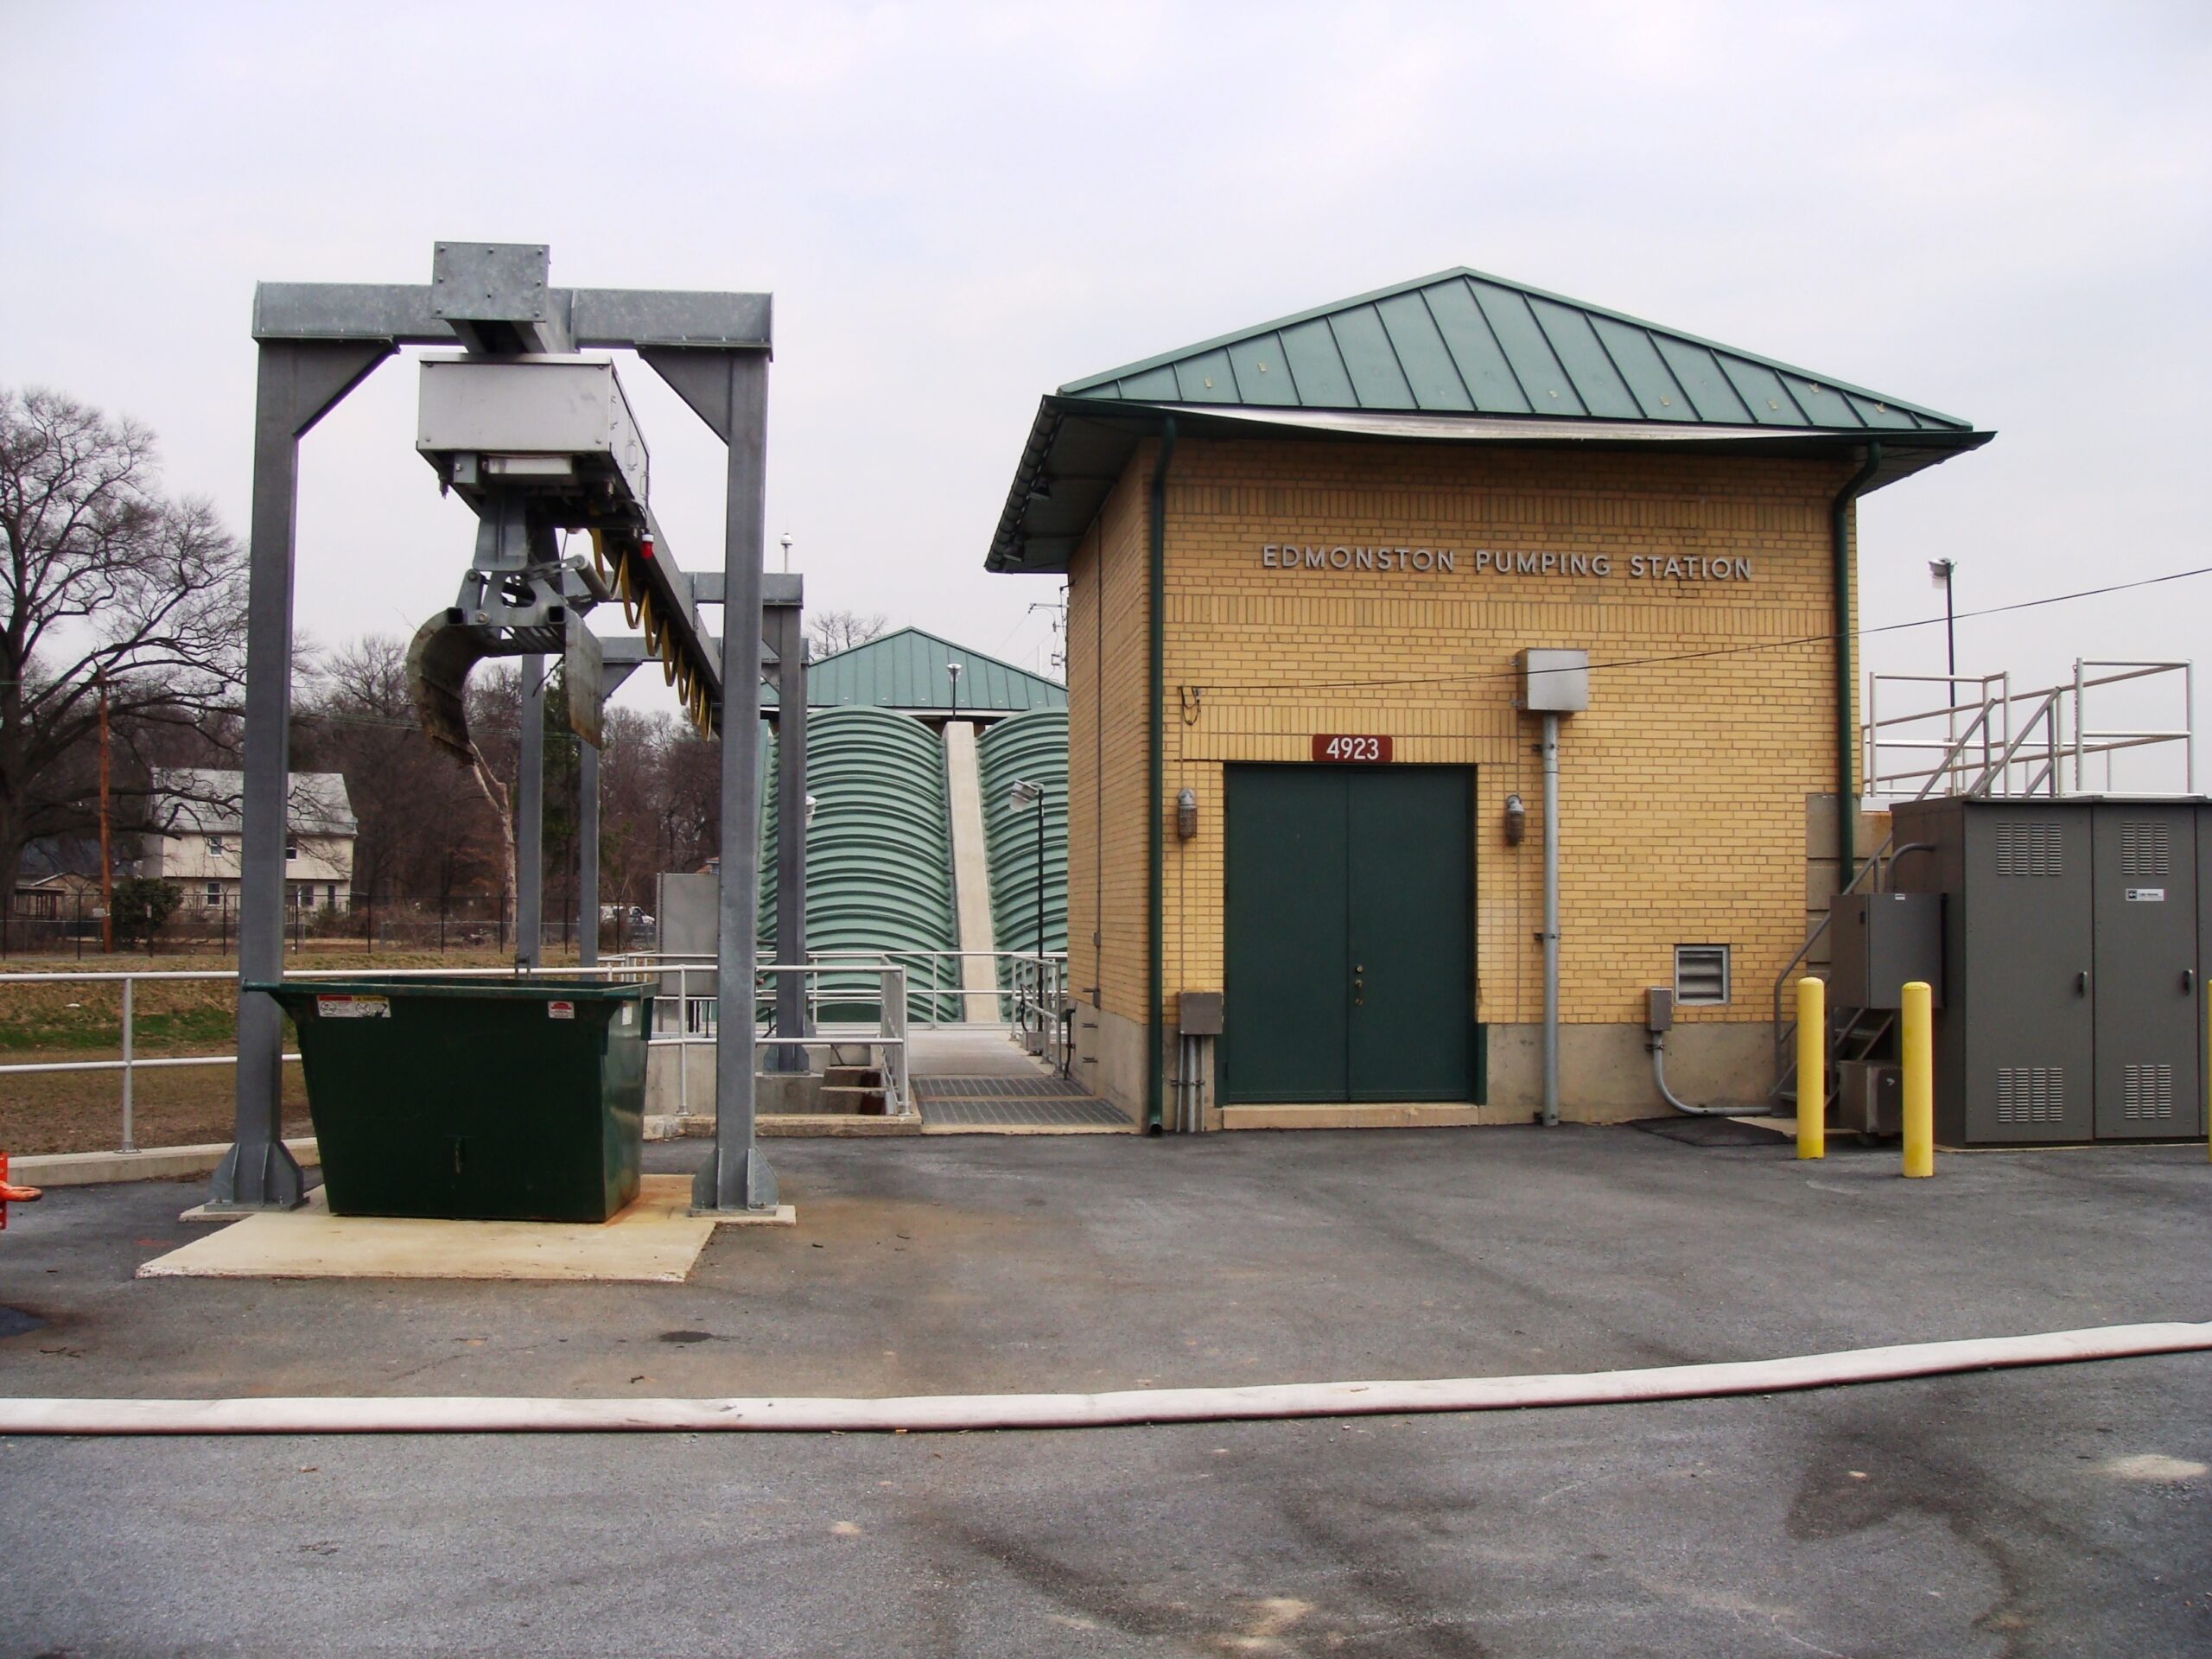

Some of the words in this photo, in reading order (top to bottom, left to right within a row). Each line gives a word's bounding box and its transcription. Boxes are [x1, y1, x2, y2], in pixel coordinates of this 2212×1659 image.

[1262, 545, 1454, 572] EDMONSTON
[1475, 550, 1611, 575] PUMPING
[1630, 555, 1751, 580] STATION
[1325, 737, 1380, 760] 4923
